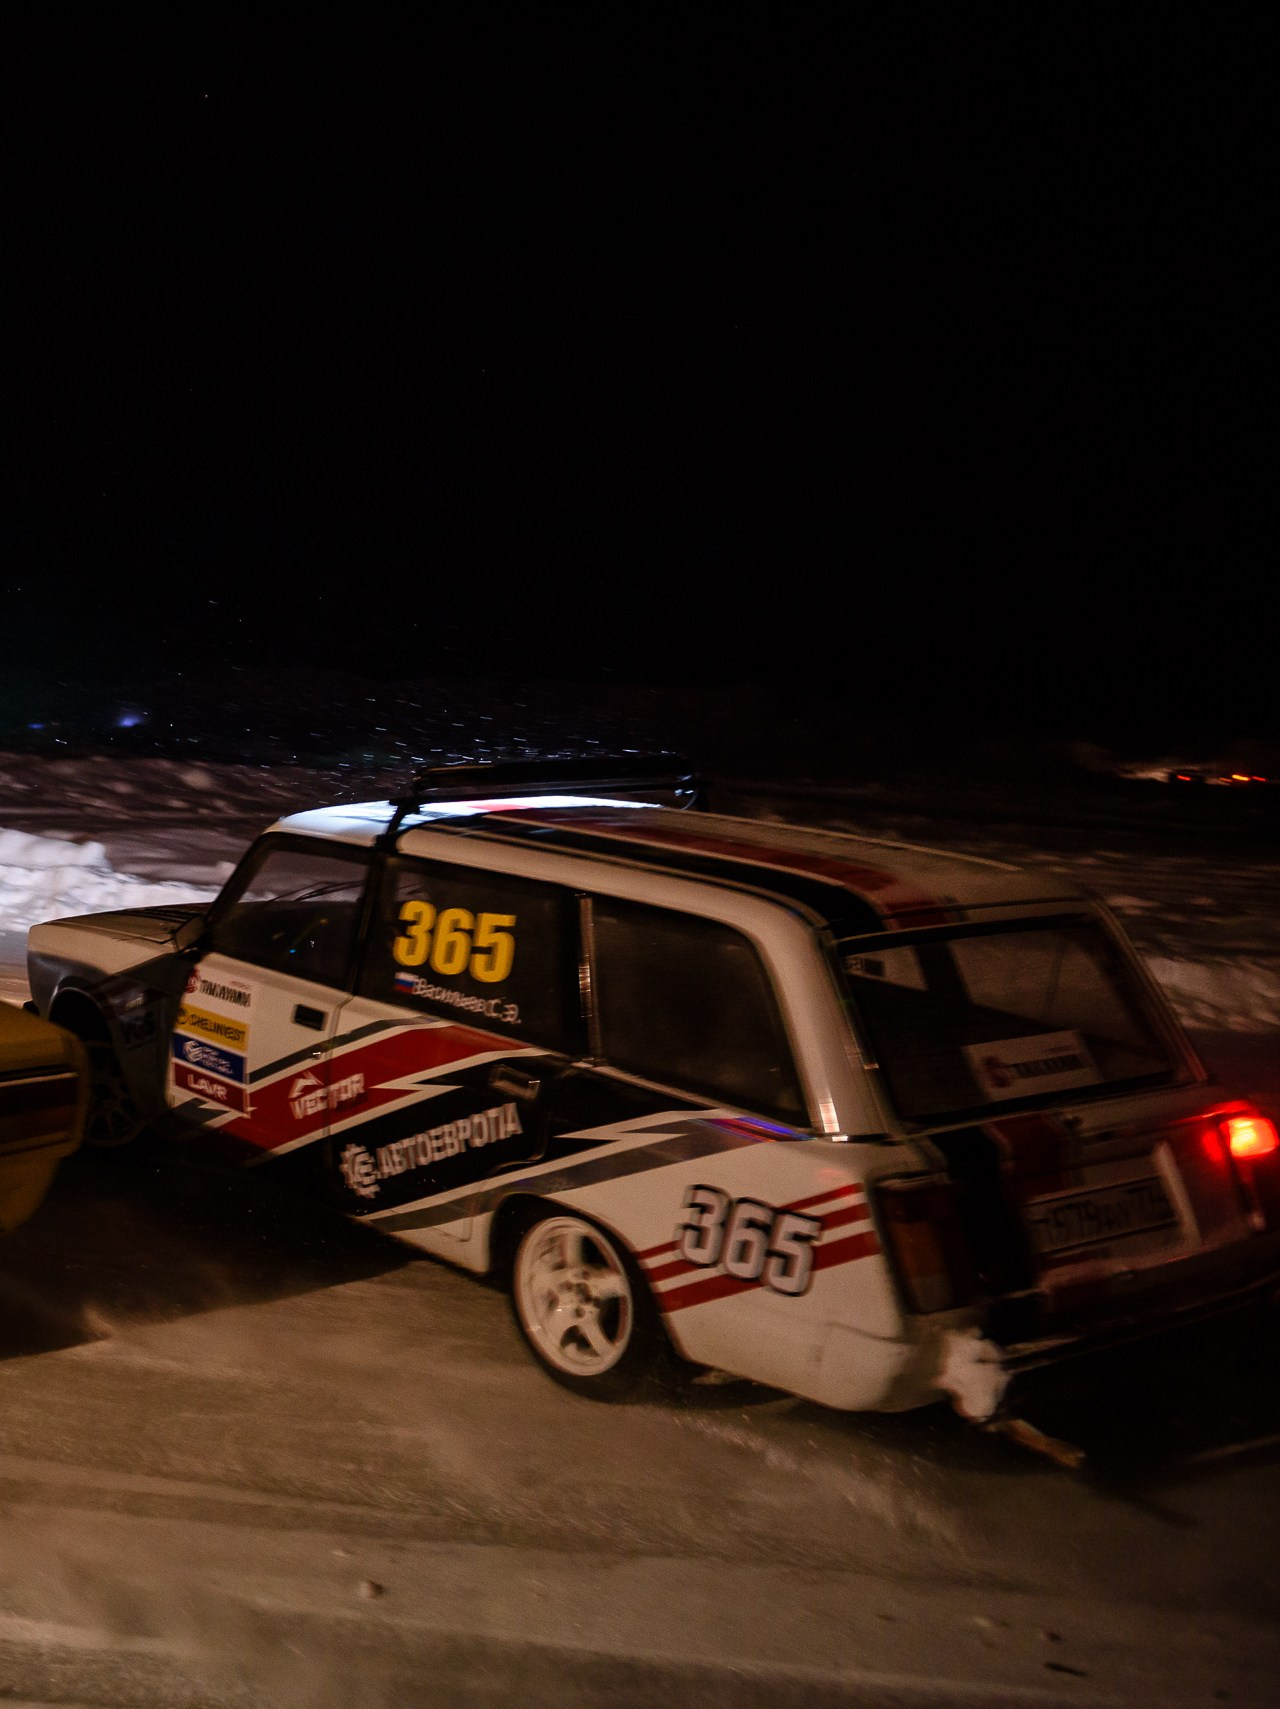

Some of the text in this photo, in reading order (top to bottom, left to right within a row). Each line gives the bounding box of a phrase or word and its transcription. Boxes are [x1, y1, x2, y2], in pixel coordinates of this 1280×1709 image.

[392, 900, 517, 983] 365
[190, 1013, 246, 1042] CHELINVEST
[289, 1072, 365, 1120] VECTOR
[376, 1102, 524, 1180] АВТОЕВРОПА
[677, 1184, 823, 1297] 365
